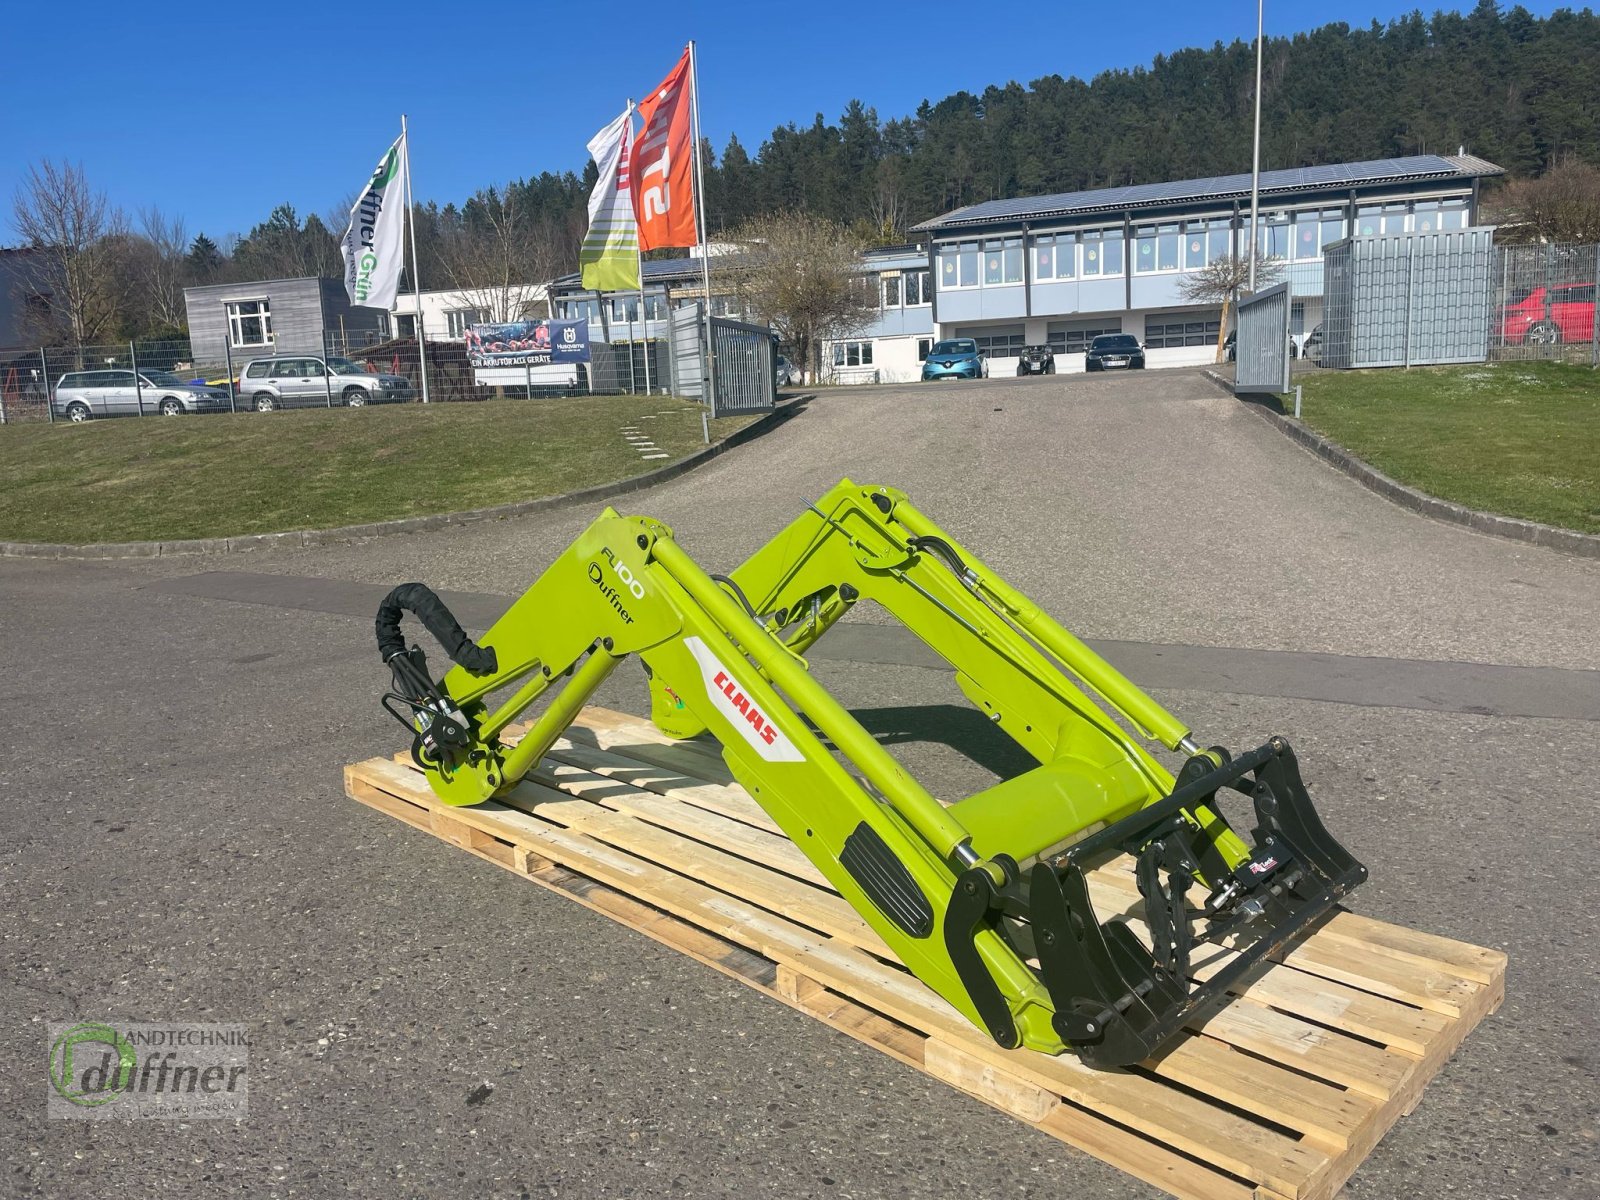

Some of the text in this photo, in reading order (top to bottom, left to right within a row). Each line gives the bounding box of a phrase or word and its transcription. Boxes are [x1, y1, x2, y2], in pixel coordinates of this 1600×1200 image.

[471, 354, 551, 367] EIN AKKU FÜR ALLE GERÄTE
[588, 561, 634, 625] Duffner
[713, 671, 778, 746] CLAAS
